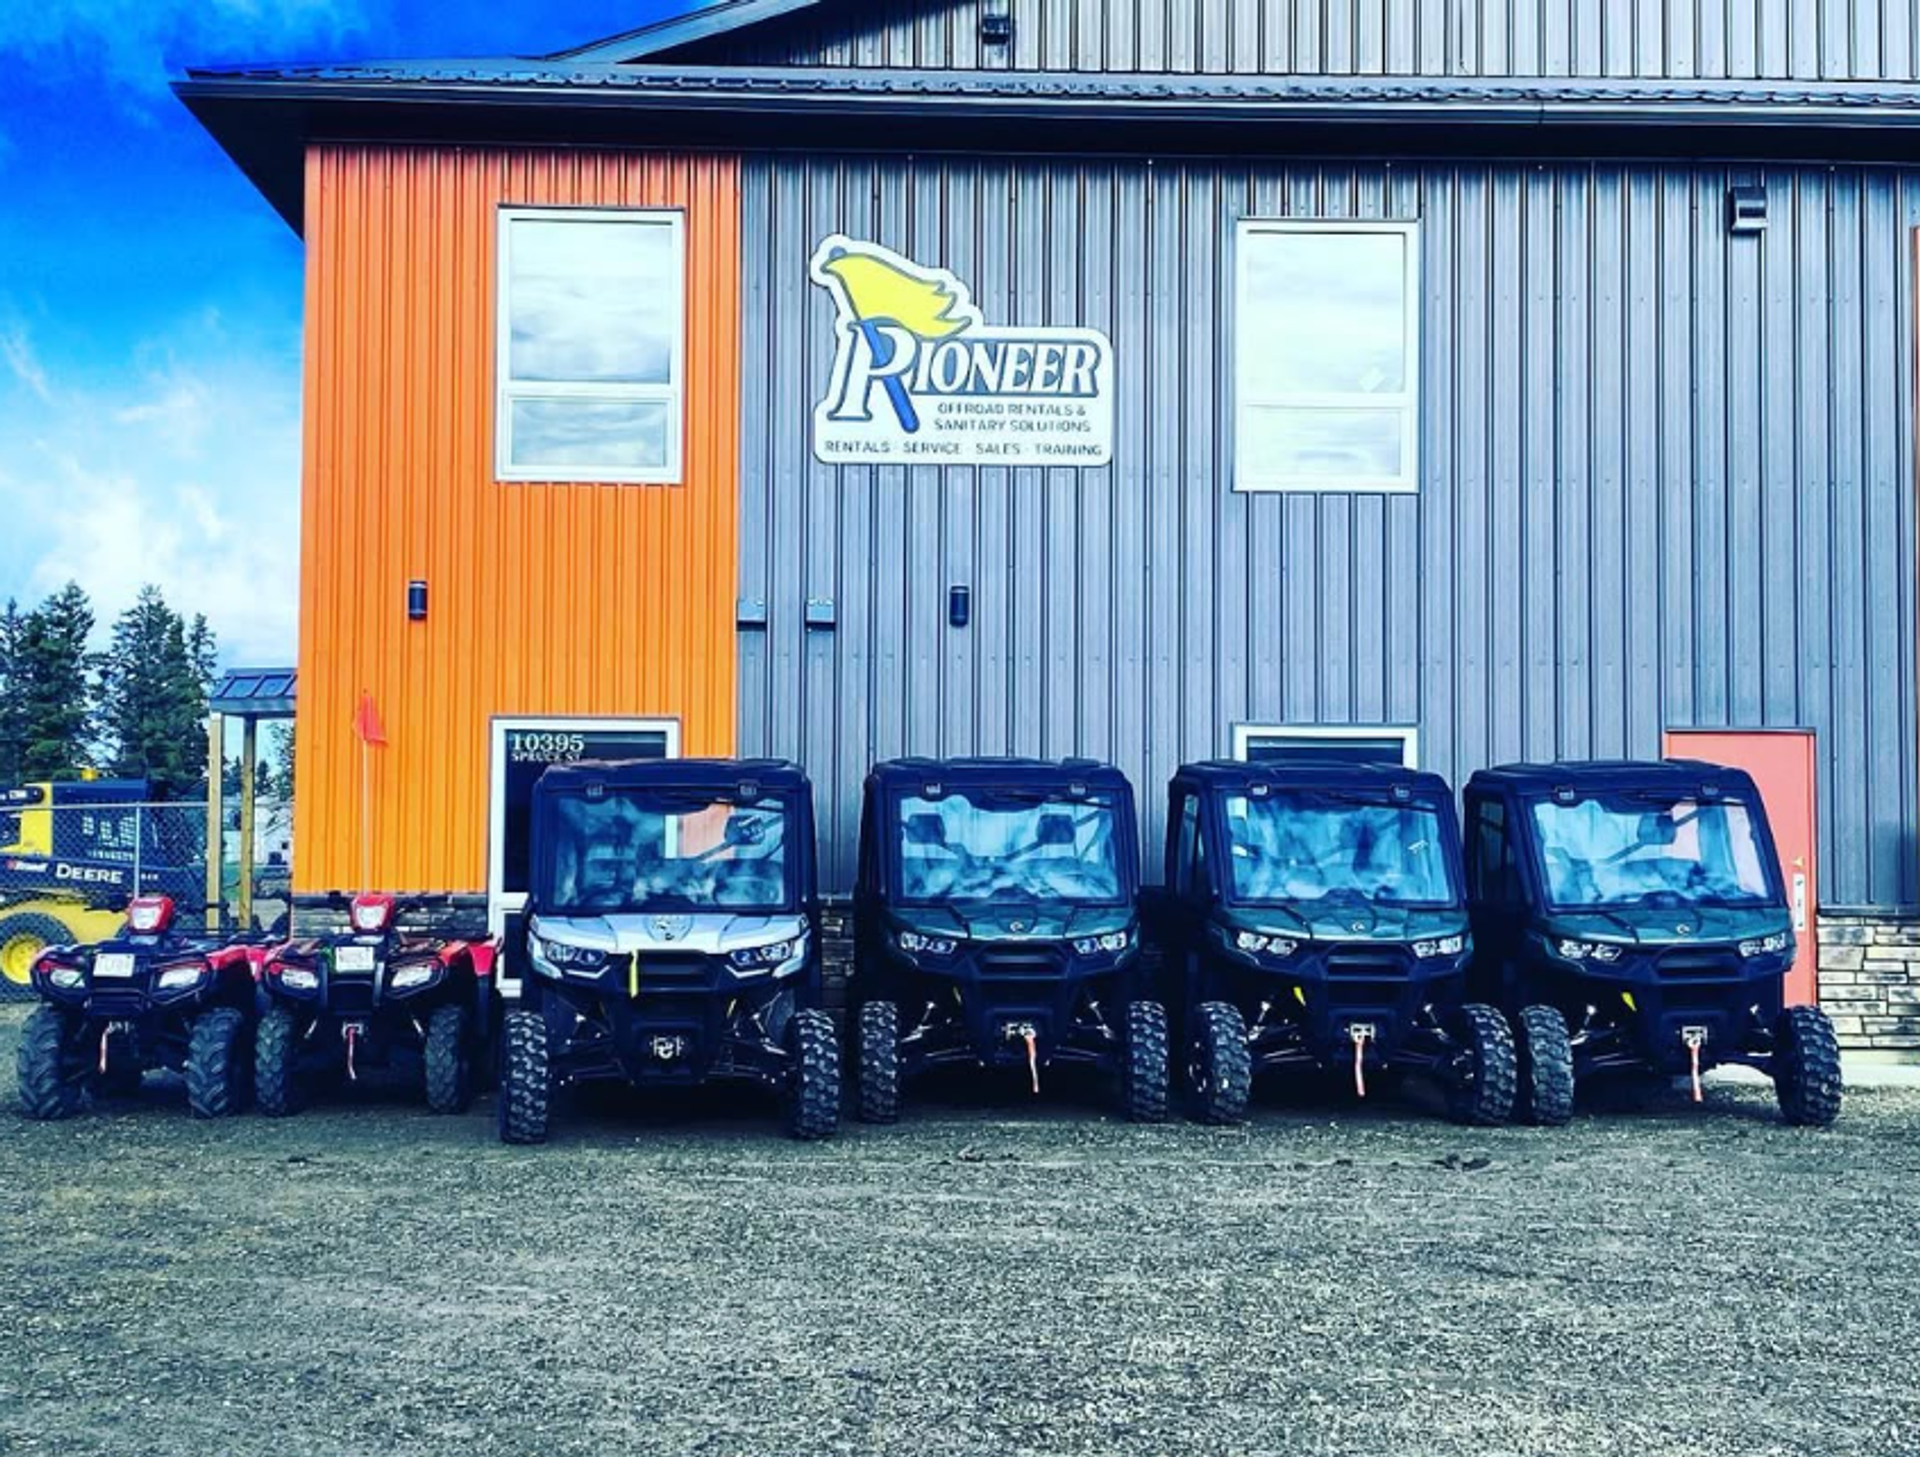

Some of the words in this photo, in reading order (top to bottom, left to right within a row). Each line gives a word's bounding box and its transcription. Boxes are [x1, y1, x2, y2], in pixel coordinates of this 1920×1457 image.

[826, 317, 1100, 424] PIONEER
[937, 402, 1004, 415] OFFROAD
[1007, 403, 1074, 417] RENTALS
[1076, 404, 1087, 417] &
[934, 418, 1006, 432] SANITARY
[1010, 419, 1092, 433] SOLUTIONS
[824, 439, 891, 454] RENTALS
[902, 441, 962, 455] SERVICE
[975, 442, 1021, 456] SALES
[1034, 442, 1103, 457] TRAINING
[512, 733, 585, 752] 10395
[55, 862, 124, 885] DEERE
